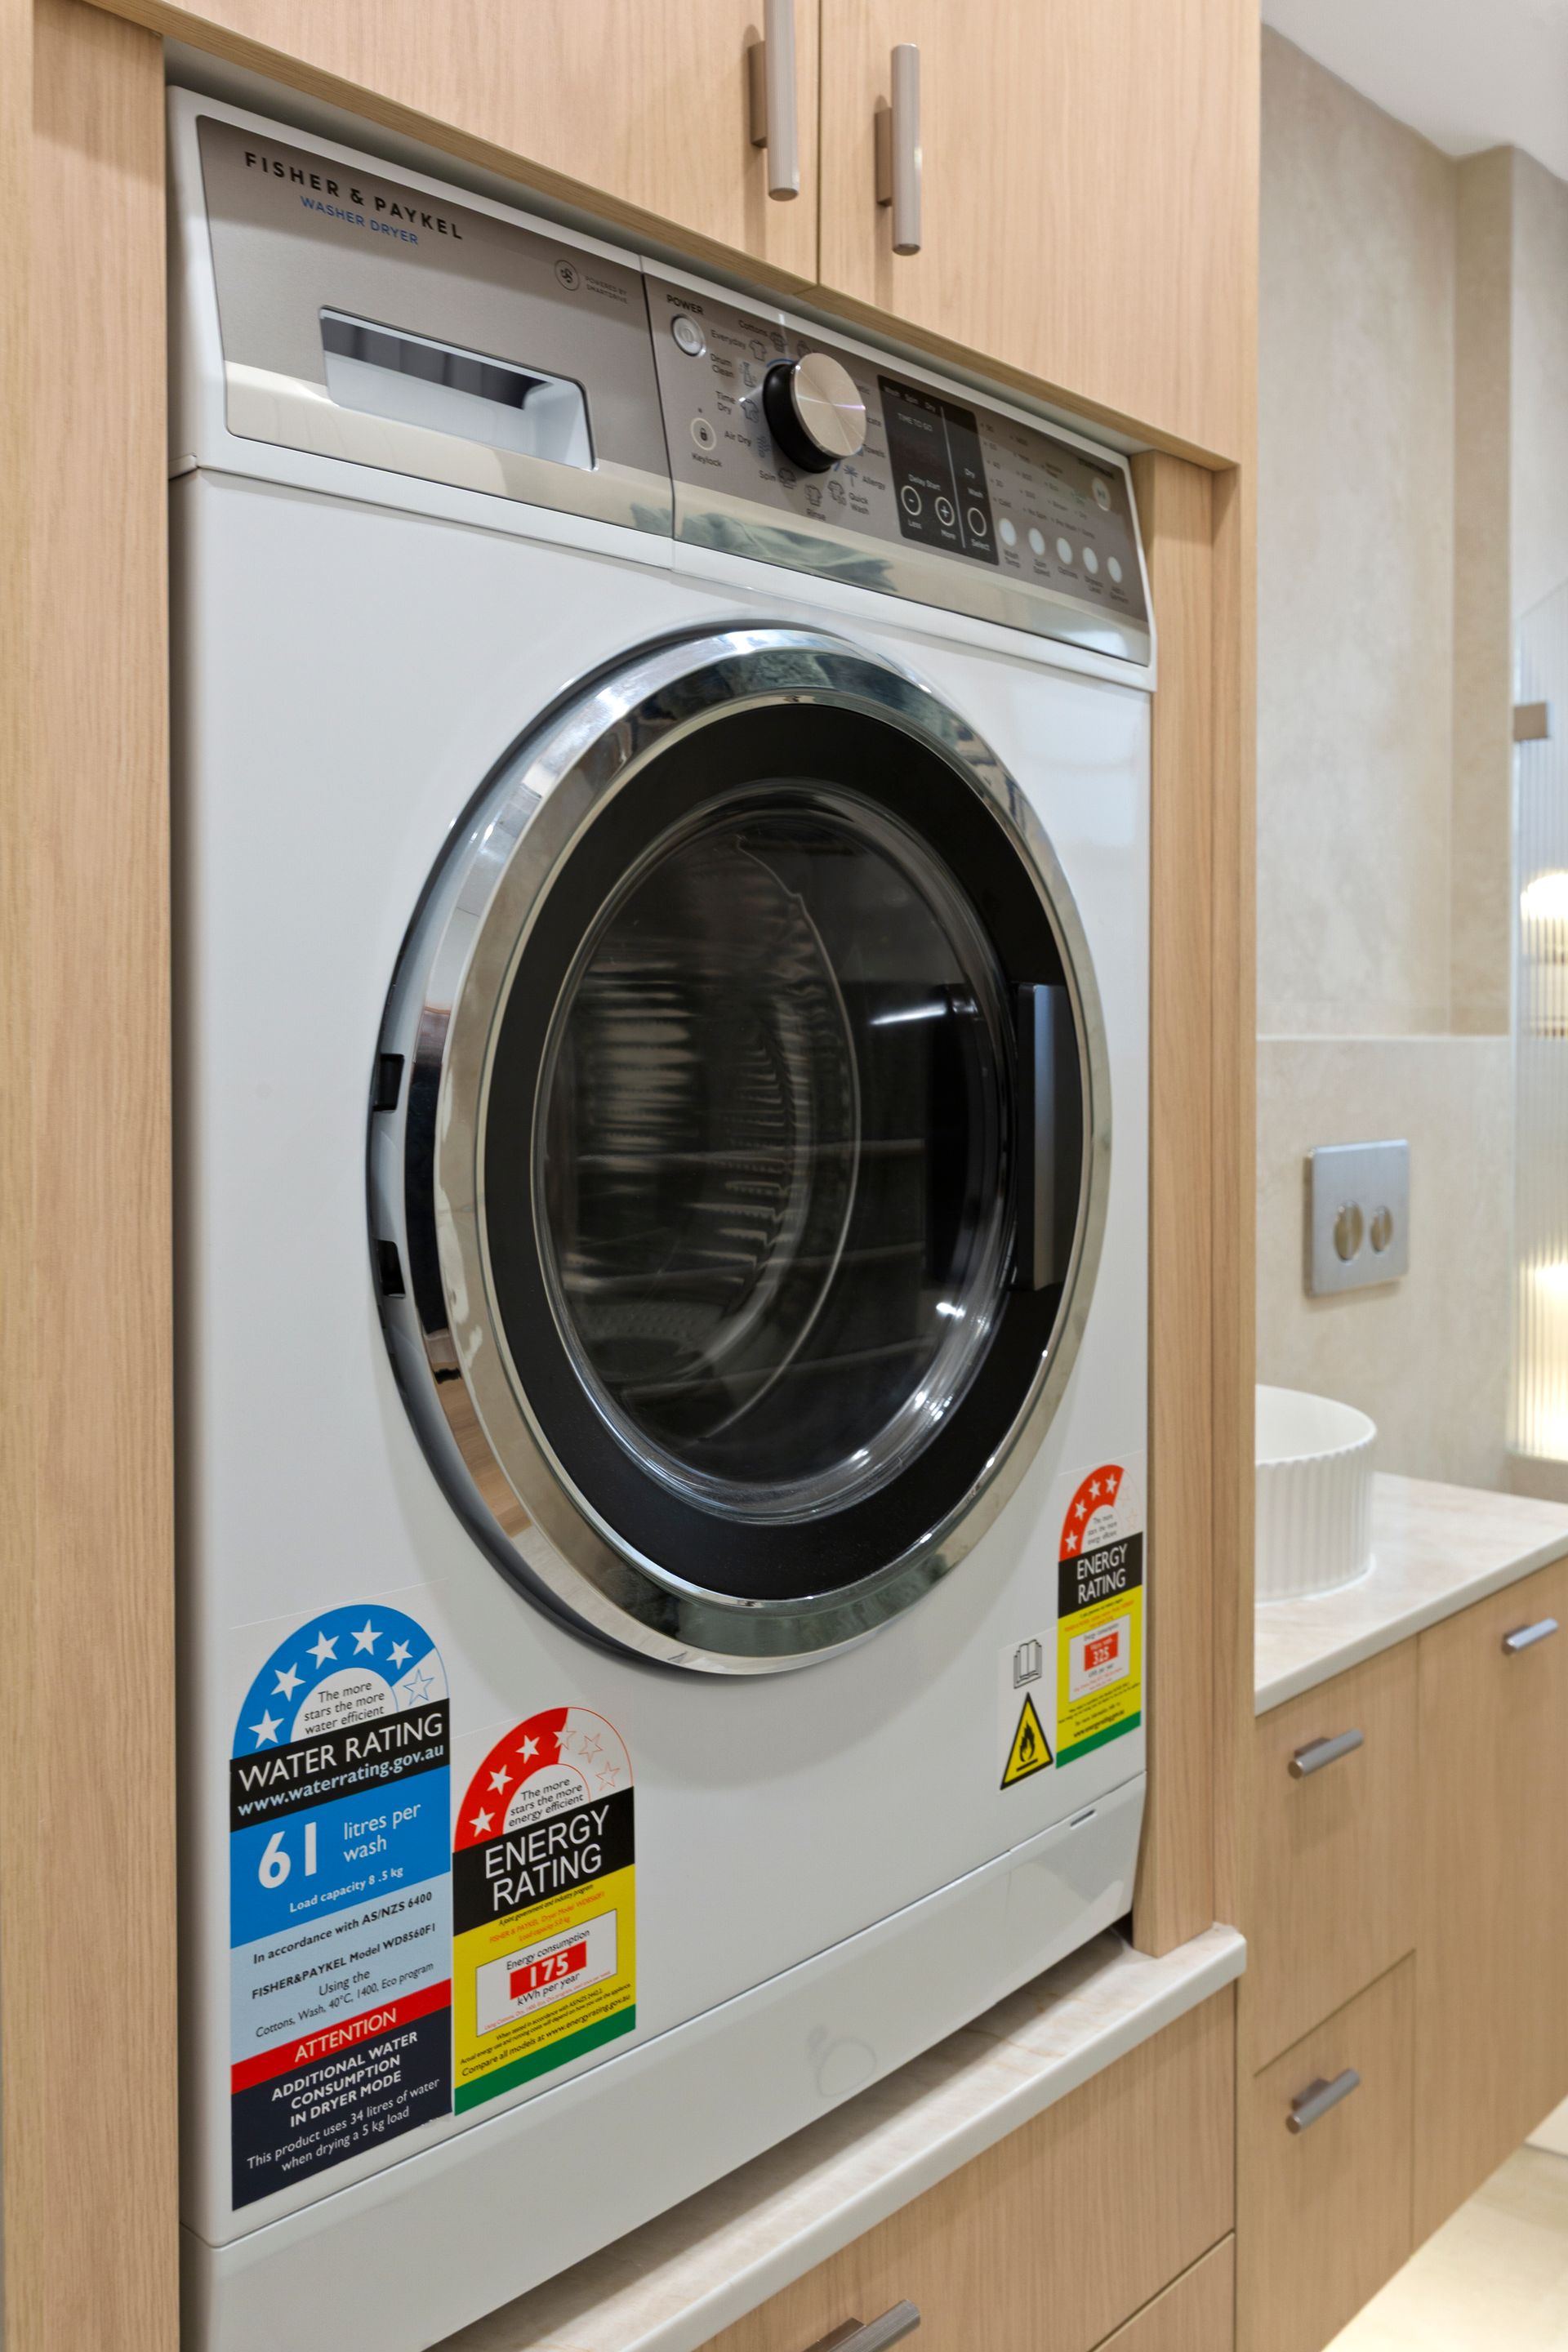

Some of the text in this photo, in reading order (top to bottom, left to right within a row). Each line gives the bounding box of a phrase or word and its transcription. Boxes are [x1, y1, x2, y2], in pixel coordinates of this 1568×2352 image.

[245, 151, 462, 240] FISHER & PAYKEL
[301, 196, 418, 245] WASHER DRYER
[666, 295, 704, 314] POWER
[710, 330, 746, 350] Everyday
[738, 319, 769, 336] Cottons
[710, 353, 732, 368] Drum
[712, 363, 733, 378] Clean
[715, 391, 736, 403] Time
[717, 403, 732, 415] Dry
[724, 430, 751, 447] Air Dry
[692, 453, 722, 467] Keylock
[759, 470, 776, 482] Spin
[849, 492, 869, 505] Quick
[1077, 1544, 1128, 1580] ENERGY
[1078, 1568, 1125, 1604] RATING
[1093, 1646, 1110, 1666] 325
[304, 1692, 385, 1722] stars the more
[318, 1682, 372, 1704] The more
[305, 1706, 384, 1735] water efficient
[238, 1713, 443, 1792] WATER RATING
[237, 1745, 444, 1816] www.waterrating.gov.au
[521, 1779, 570, 1801] The more
[509, 1794, 584, 1828] energy efficient
[510, 1784, 582, 1816] stars the more
[344, 1803, 421, 1840] litres per
[343, 1835, 387, 1862] wash
[485, 1804, 610, 1879] ENERGY
[289, 1895, 318, 1913] Load
[320, 1881, 366, 1902] capacity
[390, 1867, 403, 1879] kg
[493, 1843, 602, 1911] RATING
[253, 1891, 432, 1964] In accordance with AS/NZS 6400
[514, 1903, 543, 1921] government
[252, 1923, 435, 2000] FISHER&PAYKEL Model WD8560F1
[506, 1927, 590, 1973] Energy consumption
[318, 1970, 370, 1997] Using the
[530, 1950, 568, 1989] 175
[256, 1962, 434, 2038] Cottons, Wash, 40°C, 1400, Eco program
[517, 1971, 580, 2007] kWh per year
[295, 2008, 396, 2063] ATTENTION
[461, 2051, 497, 2081] Compare
[499, 2048, 507, 2060] all
[509, 2034, 536, 2056] models
[537, 2032, 545, 2042] at
[546, 1991, 630, 2042] www.energyrating.gov.au
[271, 2032, 418, 2102] ADDITIONAL WATER
[291, 2055, 400, 2109] CONSUMPTION
[290, 2070, 402, 2127] IN DRYER MODE
[247, 2078, 440, 2169] This product uses 34 litres of water
[281, 2105, 410, 2172] when drying a 5 kg load
